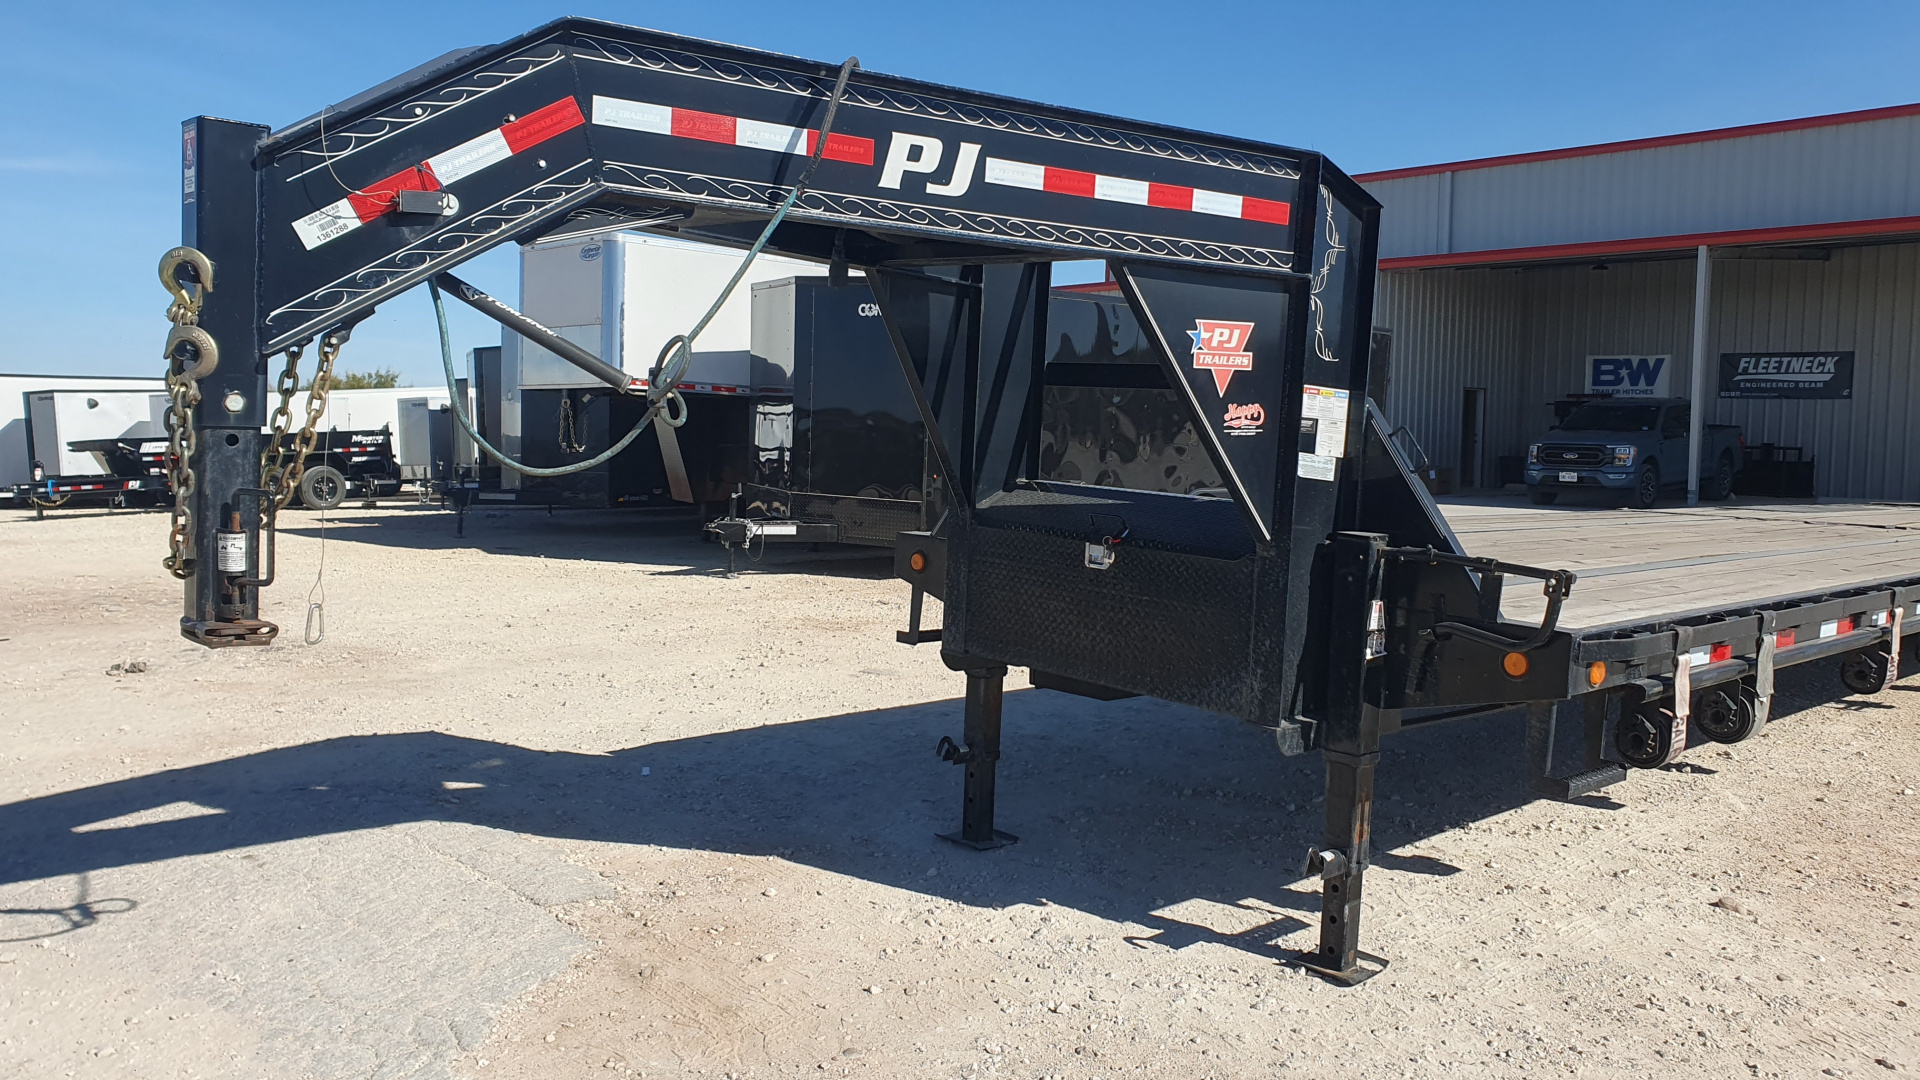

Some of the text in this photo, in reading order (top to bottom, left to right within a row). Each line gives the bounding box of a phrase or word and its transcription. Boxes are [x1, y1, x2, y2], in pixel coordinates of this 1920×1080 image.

[878, 131, 982, 197] PJ
[316, 222, 349, 242] 1361288
[1211, 328, 1240, 348] PJ
[1199, 355, 1249, 366] TRAILERS
[1738, 356, 1840, 373] FLEETNECK
